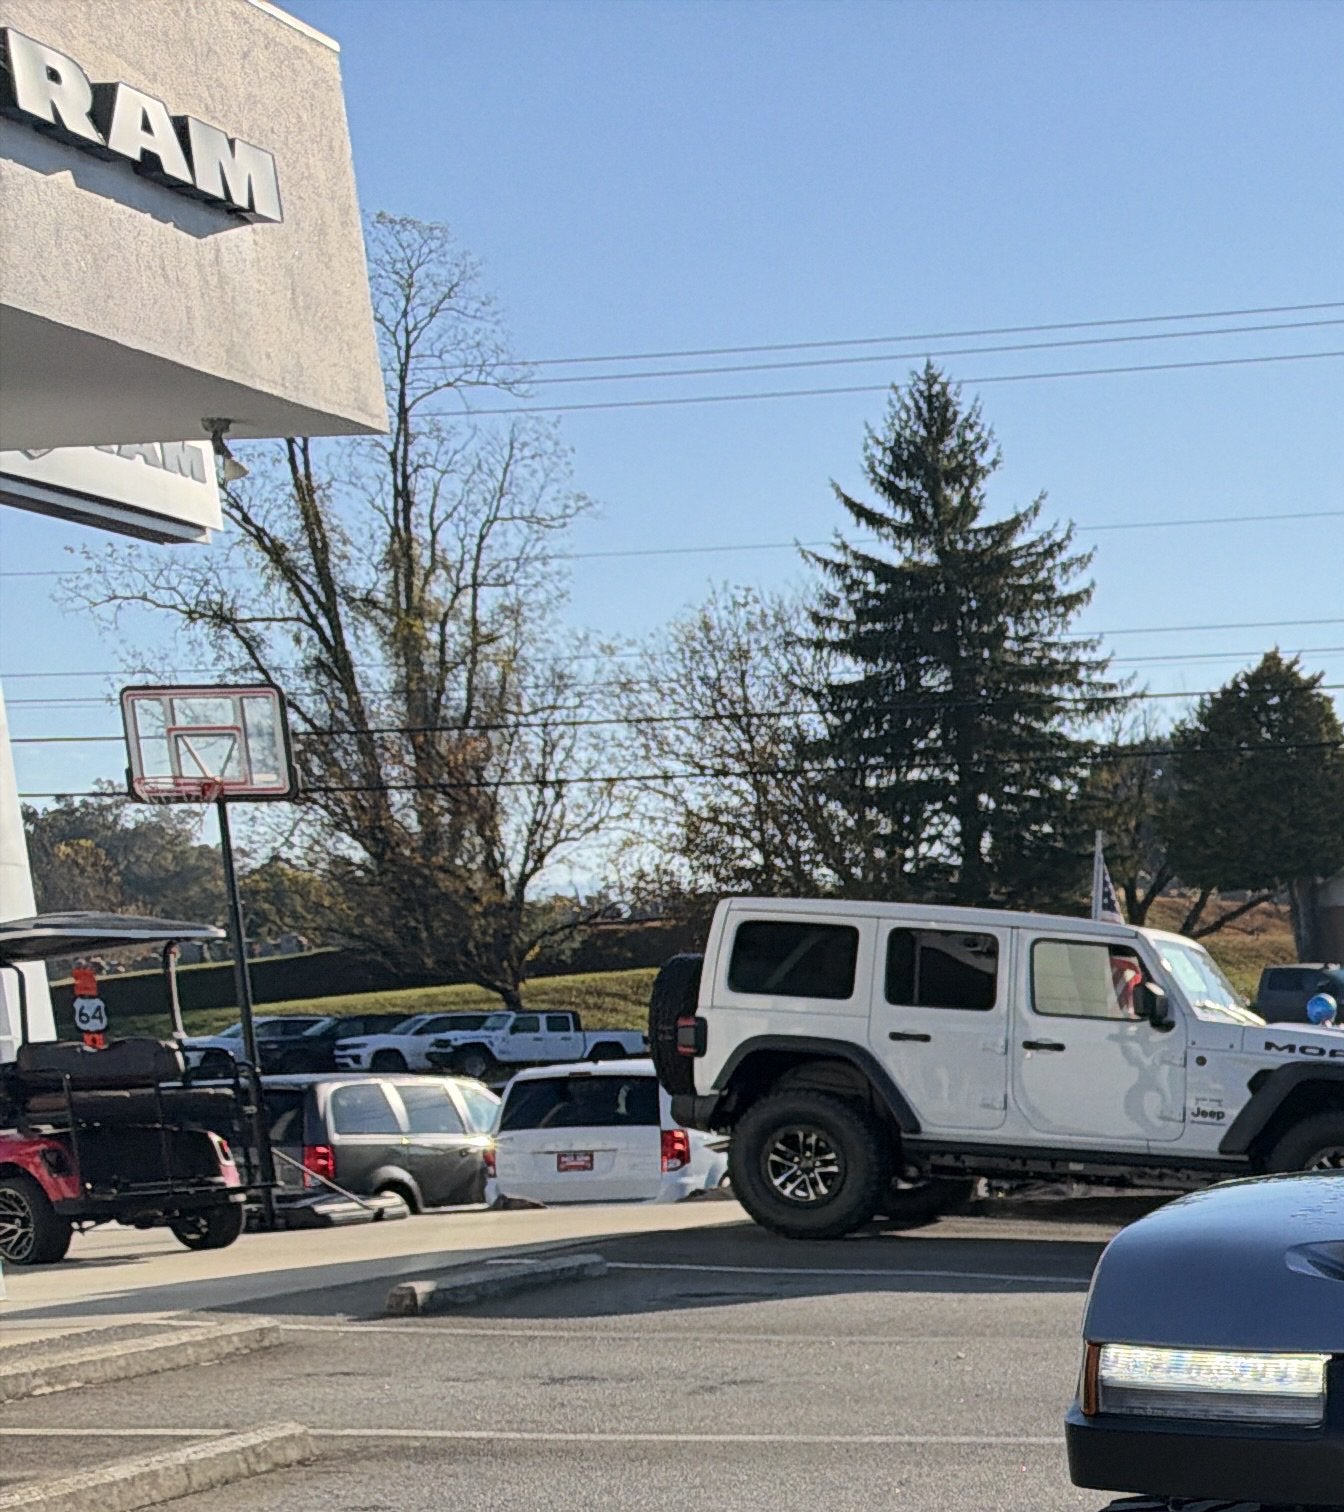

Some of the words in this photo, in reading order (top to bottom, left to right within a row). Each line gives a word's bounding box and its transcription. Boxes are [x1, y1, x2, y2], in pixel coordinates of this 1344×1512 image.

[6, 27, 283, 223] RAM
[79, 1005, 104, 1024] 64
[1191, 1106, 1226, 1121] Jeep
